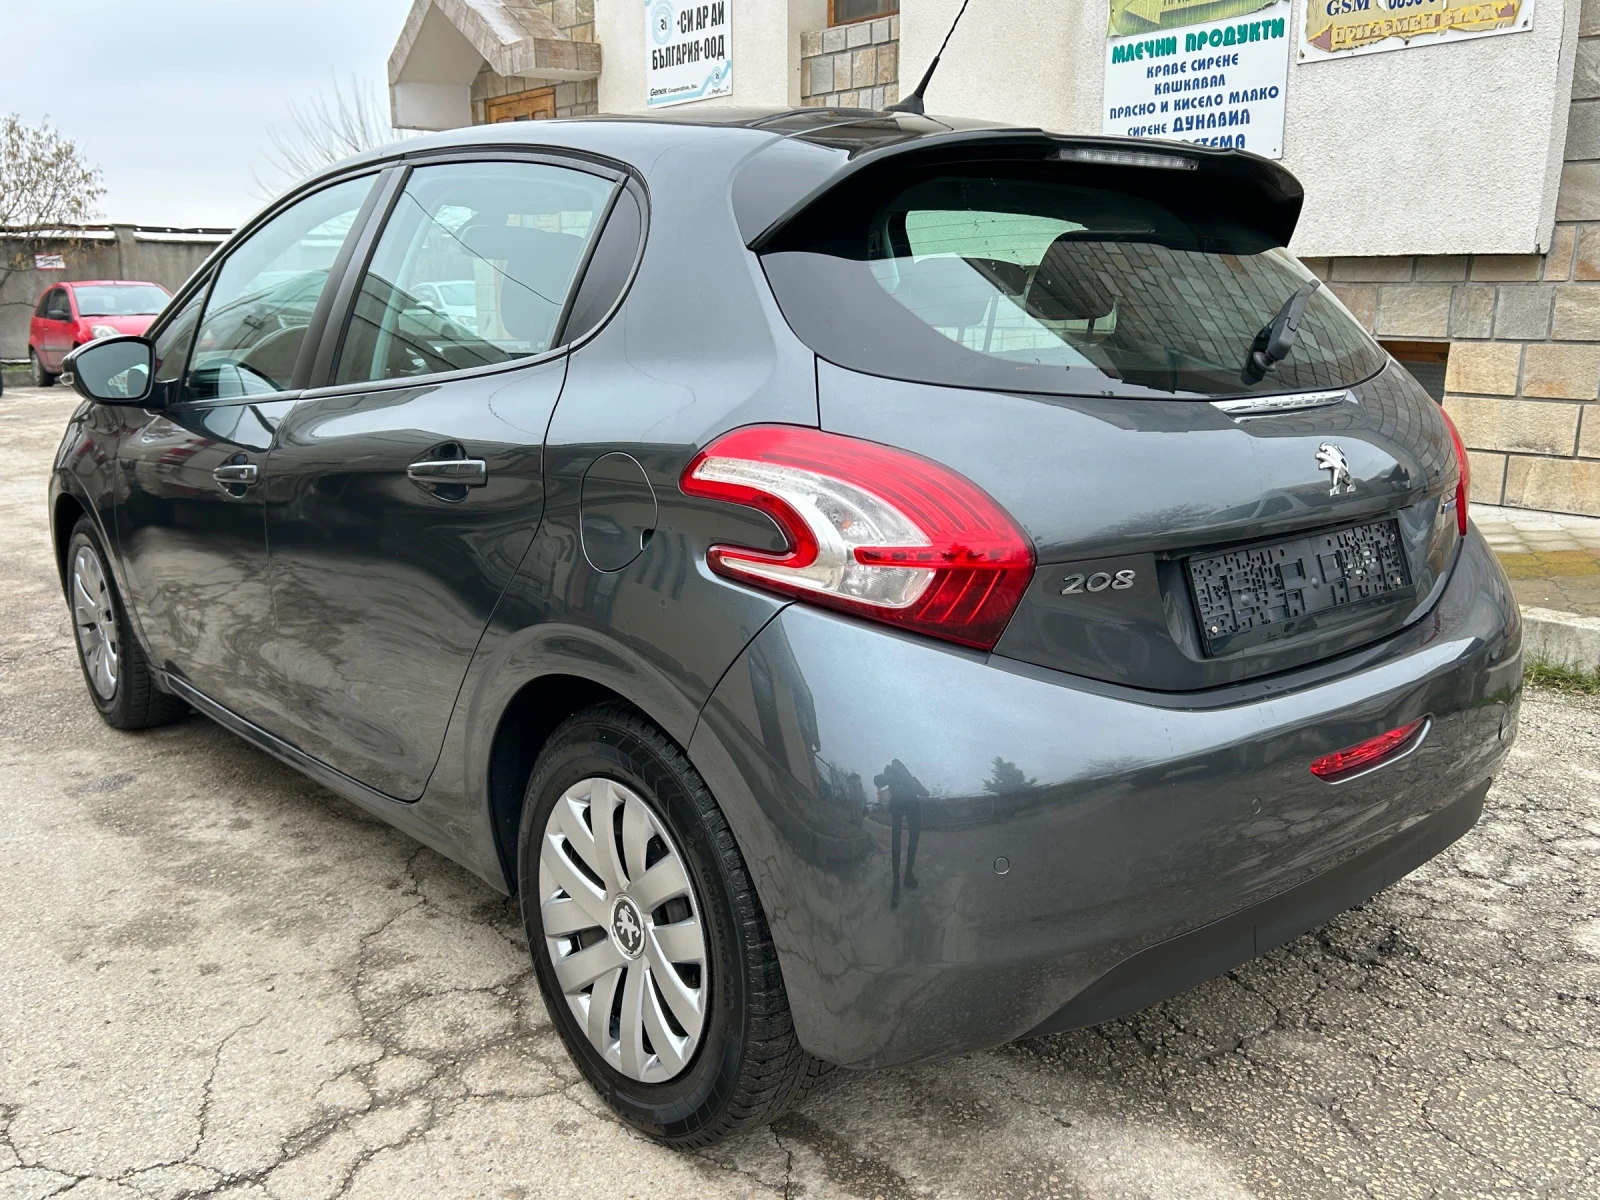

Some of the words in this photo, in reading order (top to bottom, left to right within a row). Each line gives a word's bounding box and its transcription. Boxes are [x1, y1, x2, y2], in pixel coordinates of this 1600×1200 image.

[696, 5, 708, 31] АР
[1111, 36, 1177, 64] МЛЕЧНИ
[1185, 17, 1285, 53] ПРОДУКТИ
[1146, 61, 1187, 79] КРАВЕ
[1190, 53, 1239, 71] СИРЕНЕ
[1154, 73, 1226, 96] КАШКАВАЛ
[1109, 102, 1156, 120] ПРЯСНО
[1160, 101, 1169, 113] И
[1173, 94, 1223, 112] КИСЕЛО
[1228, 85, 1279, 104] МЛЯКО
[1127, 123, 1167, 137] СИРЕНЕ
[1060, 569, 1136, 595] 208
